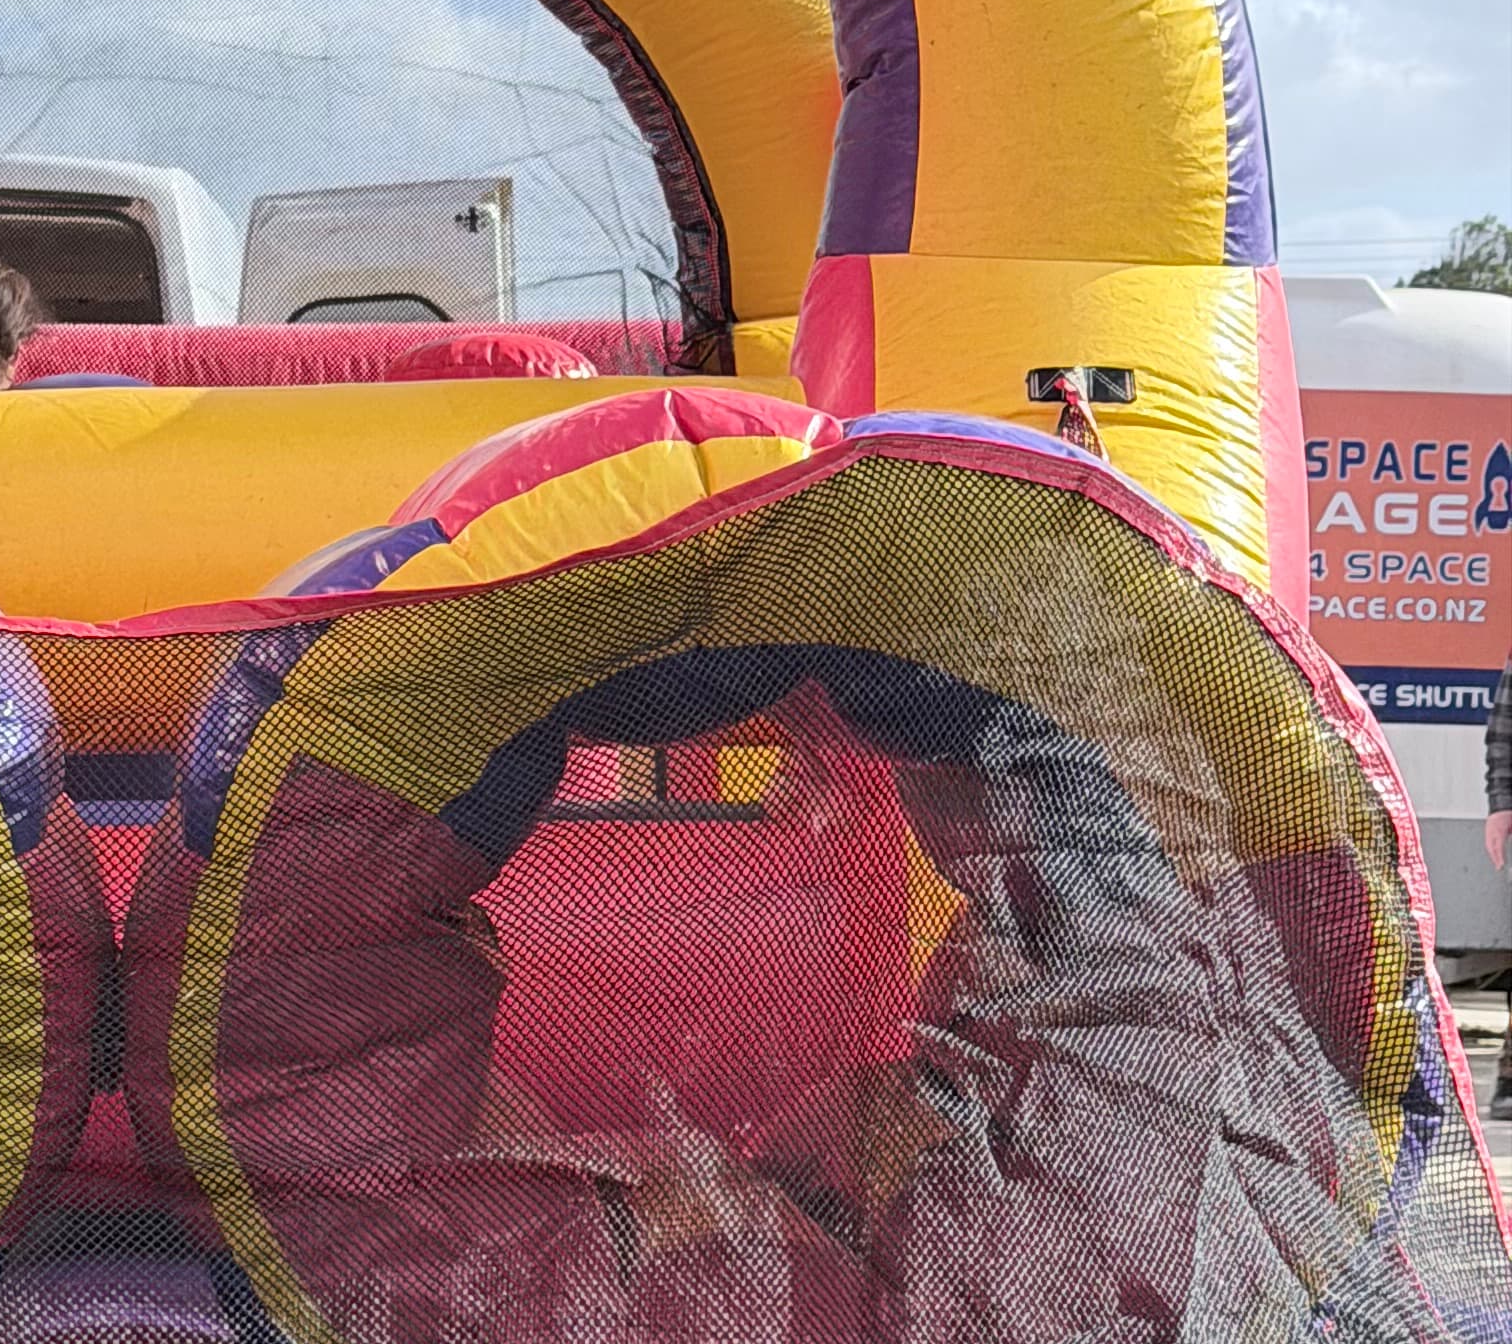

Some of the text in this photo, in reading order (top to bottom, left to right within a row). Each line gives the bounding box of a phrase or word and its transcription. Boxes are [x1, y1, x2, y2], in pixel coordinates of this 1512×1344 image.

[1305, 440, 1470, 483] SPACE
[1315, 491, 1469, 536] AGE
[1345, 551, 1490, 585] SPACE
